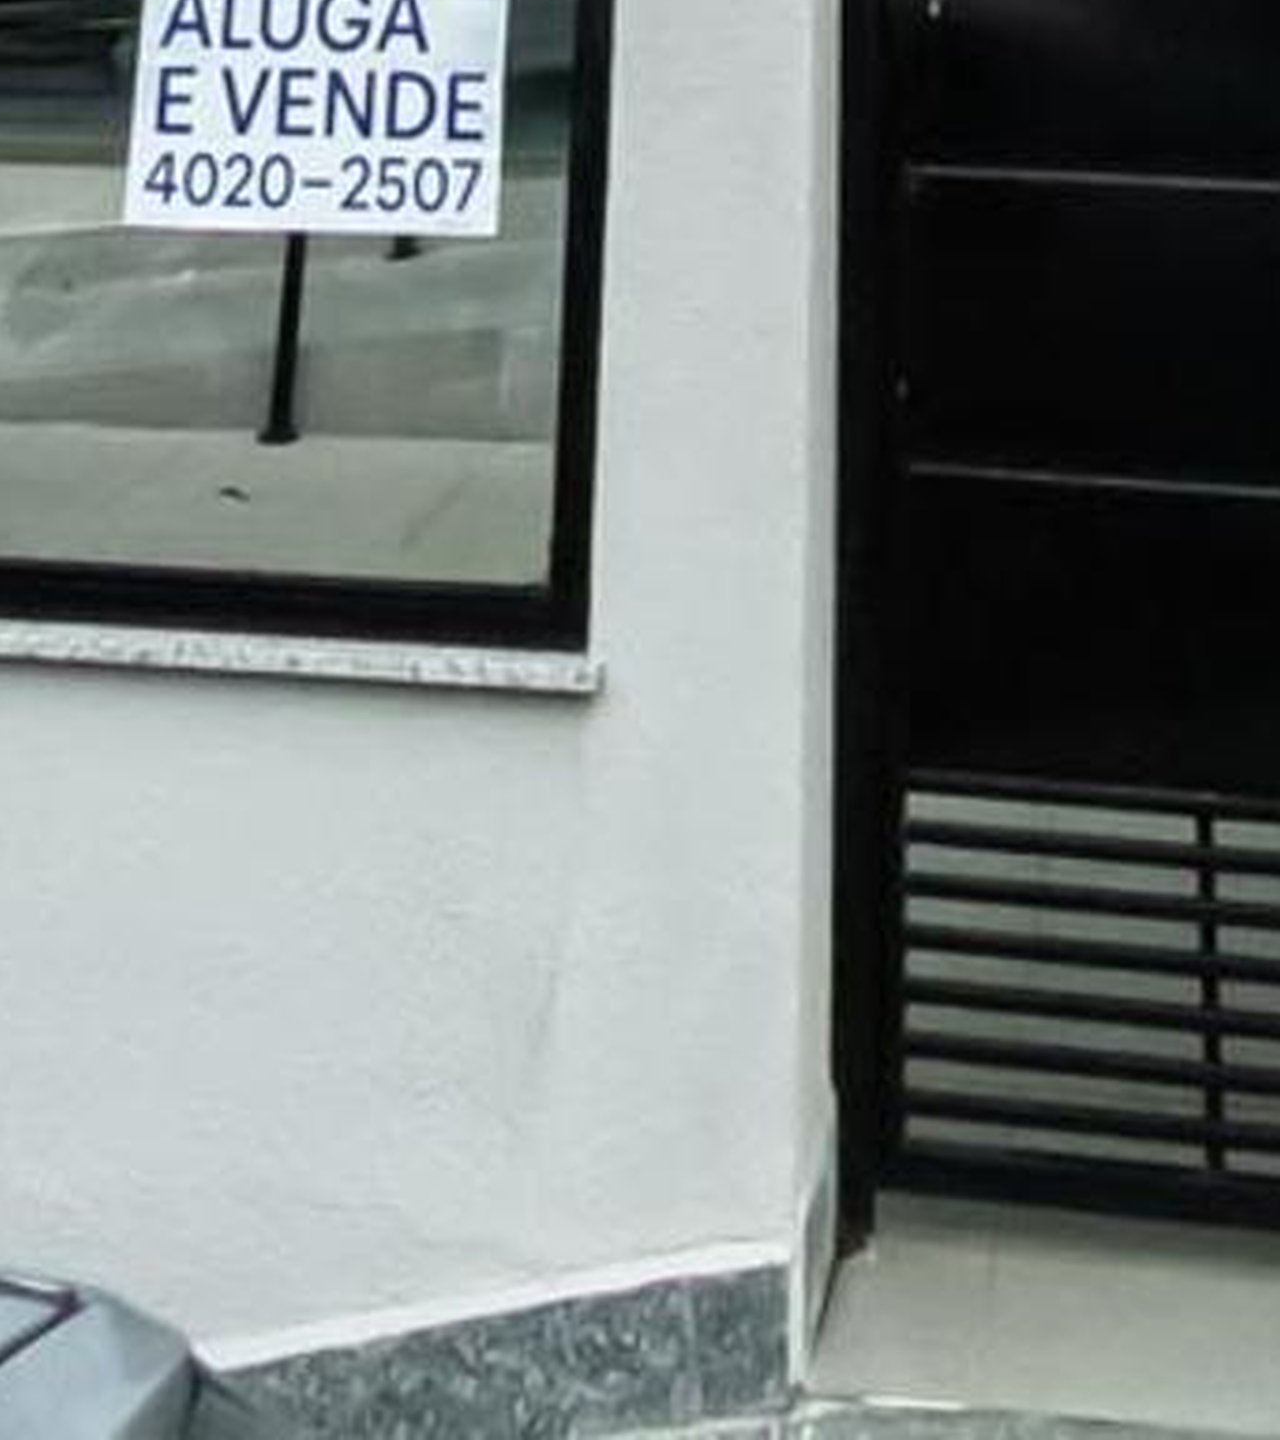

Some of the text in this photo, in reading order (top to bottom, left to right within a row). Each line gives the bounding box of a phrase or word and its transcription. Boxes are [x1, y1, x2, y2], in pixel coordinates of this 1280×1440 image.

[155, 66, 488, 141] E VENDE
[144, 151, 485, 213] 4020-2507
